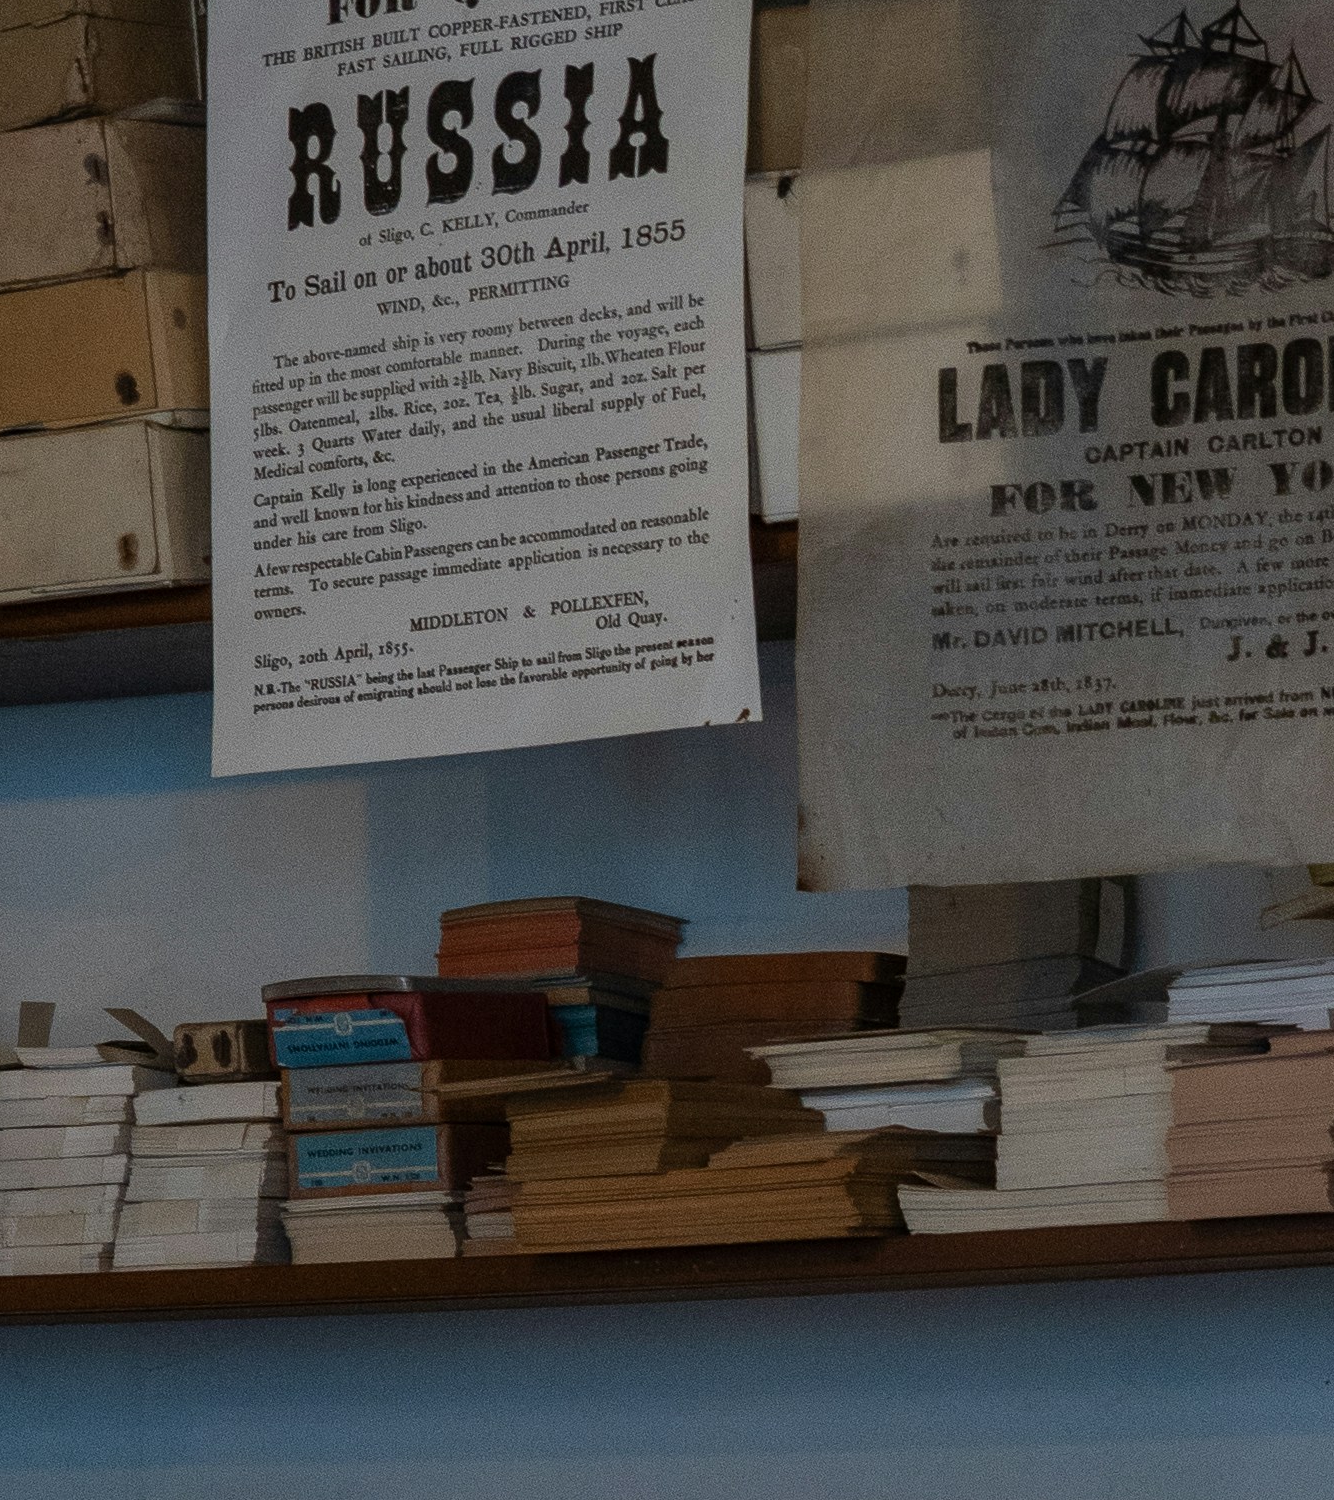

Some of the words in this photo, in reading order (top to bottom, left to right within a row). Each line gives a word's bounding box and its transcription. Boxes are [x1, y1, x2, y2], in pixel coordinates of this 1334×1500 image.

[261, 48, 297, 68] THE
[301, 35, 365, 62] BRITISH
[371, 25, 421, 49] BUILT
[426, 4, 592, 39] COPPER-FASTENED,
[336, 55, 376, 77] FAST
[381, 45, 452, 69] SAILING,
[458, 37, 503, 57] FULL
[509, 28, 578, 51] RIGGED
[583, 21, 624, 41] SHIP
[286, 51, 669, 231] RUSSIA
[357, 232, 372, 247] of
[377, 226, 415, 245] Sligo,
[418, 221, 435, 237] C.
[440, 210, 499, 234] KELLY,
[503, 199, 590, 223] Commander
[266, 278, 297, 304] To
[303, 268, 347, 297] Sail
[352, 269, 378, 290] on
[384, 265, 408, 285] or
[413, 250, 473, 281] about
[479, 239, 536, 270] 30th
[542, 229, 611, 263] April,
[620, 217, 686, 250] 1855
[375, 295, 426, 316] WIND,
[430, 293, 460, 308] &c.,
[467, 273, 570, 303] PERMITTING
[937, 355, 1108, 444] LADY
[1083, 436, 1189, 465] CAPTAIN
[1206, 425, 1323, 453] CARLTON
[989, 479, 1098, 517] FOR
[1127, 466, 1233, 507] NEW
[408, 606, 508, 633] MIDDLETON
[521, 604, 536, 619] &
[549, 589, 649, 616] POLLEXFEN,
[594, 612, 622, 630] Old
[626, 610, 668, 629] Quay.
[1225, 634, 1252, 662] J.
[1264, 633, 1289, 660] &
[1302, 628, 1328, 658] J.
[307, 1147, 354, 1158] WEDDING
